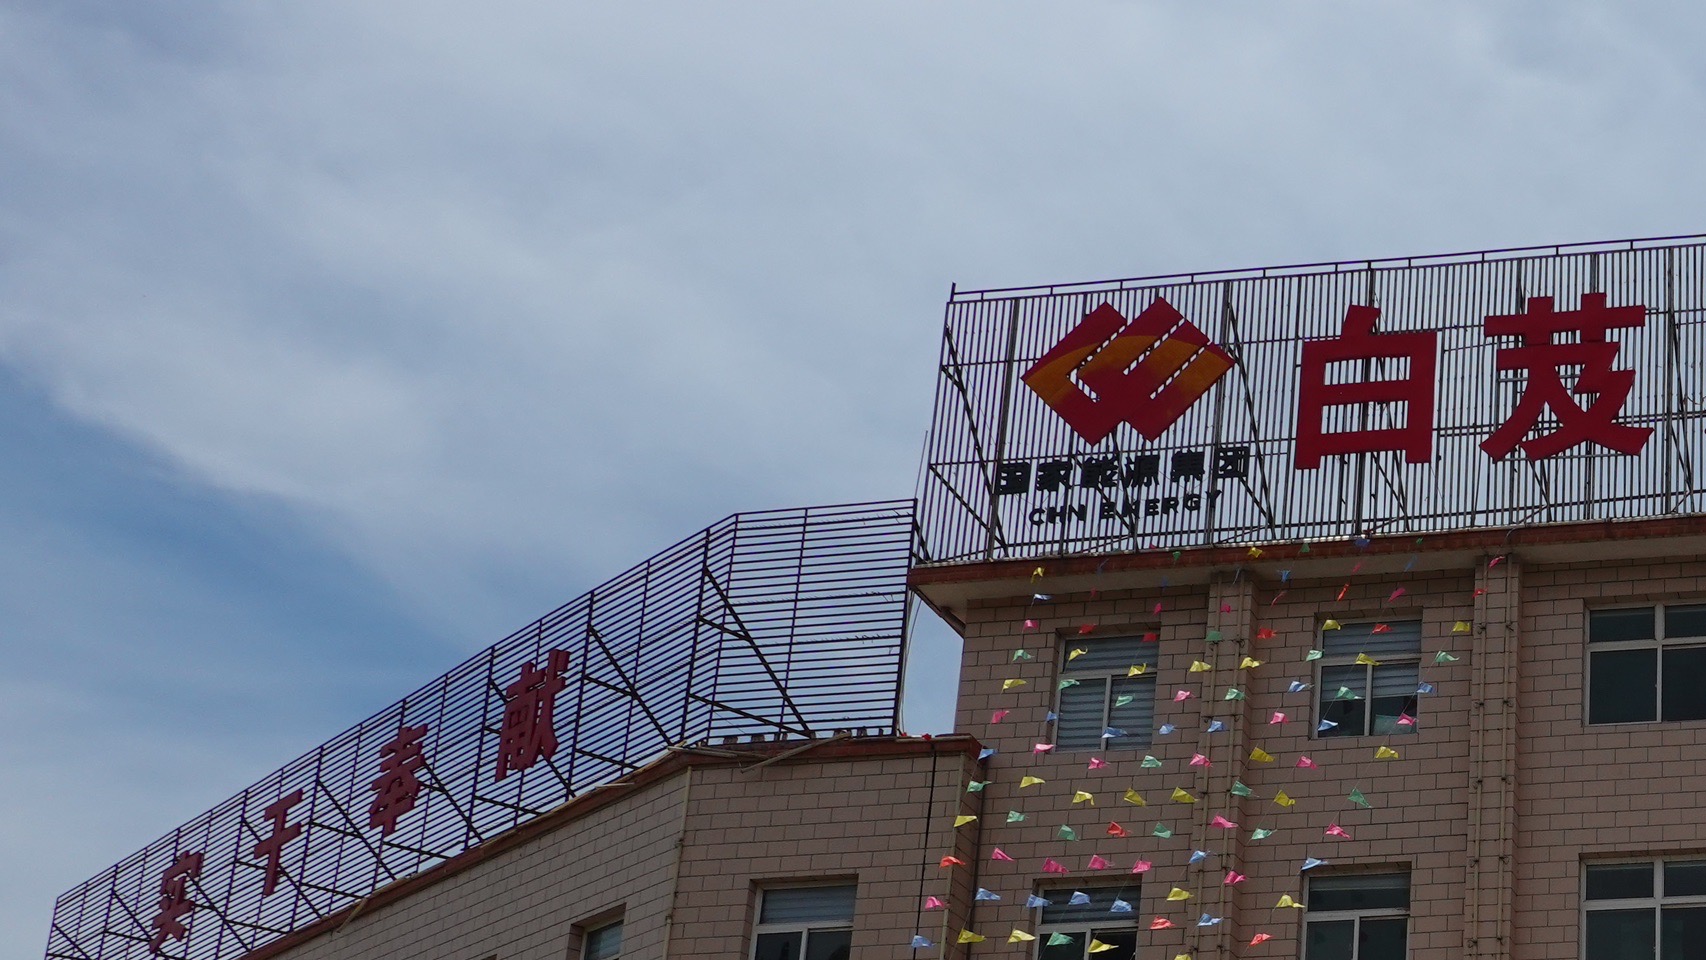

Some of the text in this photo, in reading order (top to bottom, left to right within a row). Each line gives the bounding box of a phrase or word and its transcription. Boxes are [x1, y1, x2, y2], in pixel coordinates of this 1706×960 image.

[1000, 446, 1250, 495] 国家能源集团
[1029, 489, 1222, 526] CHN ENERGY
[150, 648, 570, 953] 实干奉献
